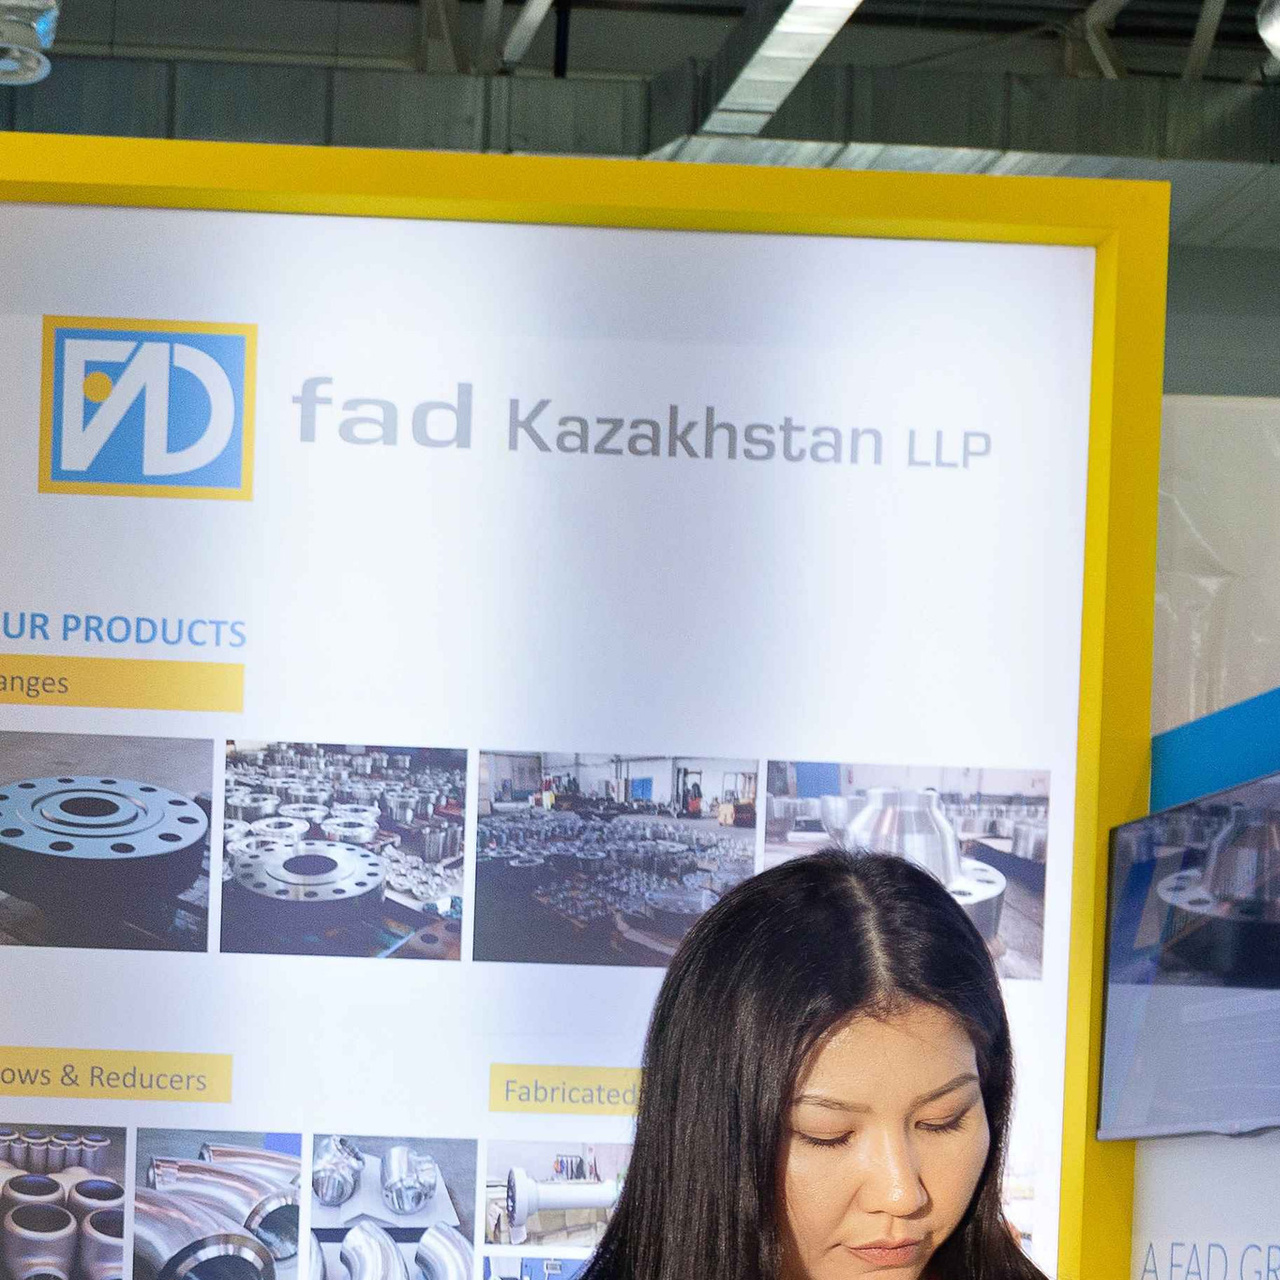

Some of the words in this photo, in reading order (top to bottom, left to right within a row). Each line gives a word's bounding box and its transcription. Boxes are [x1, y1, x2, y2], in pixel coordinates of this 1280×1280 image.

[60, 337, 236, 477] FAD
[291, 376, 474, 449] fad
[507, 397, 883, 466] Kazakhstan
[907, 428, 993, 470] LLP
[61, 612, 248, 648] PRODUCTS
[60, 1063, 80, 1087] &
[89, 1065, 208, 1092] Reducers
[504, 1078, 638, 1106] Fabricated
